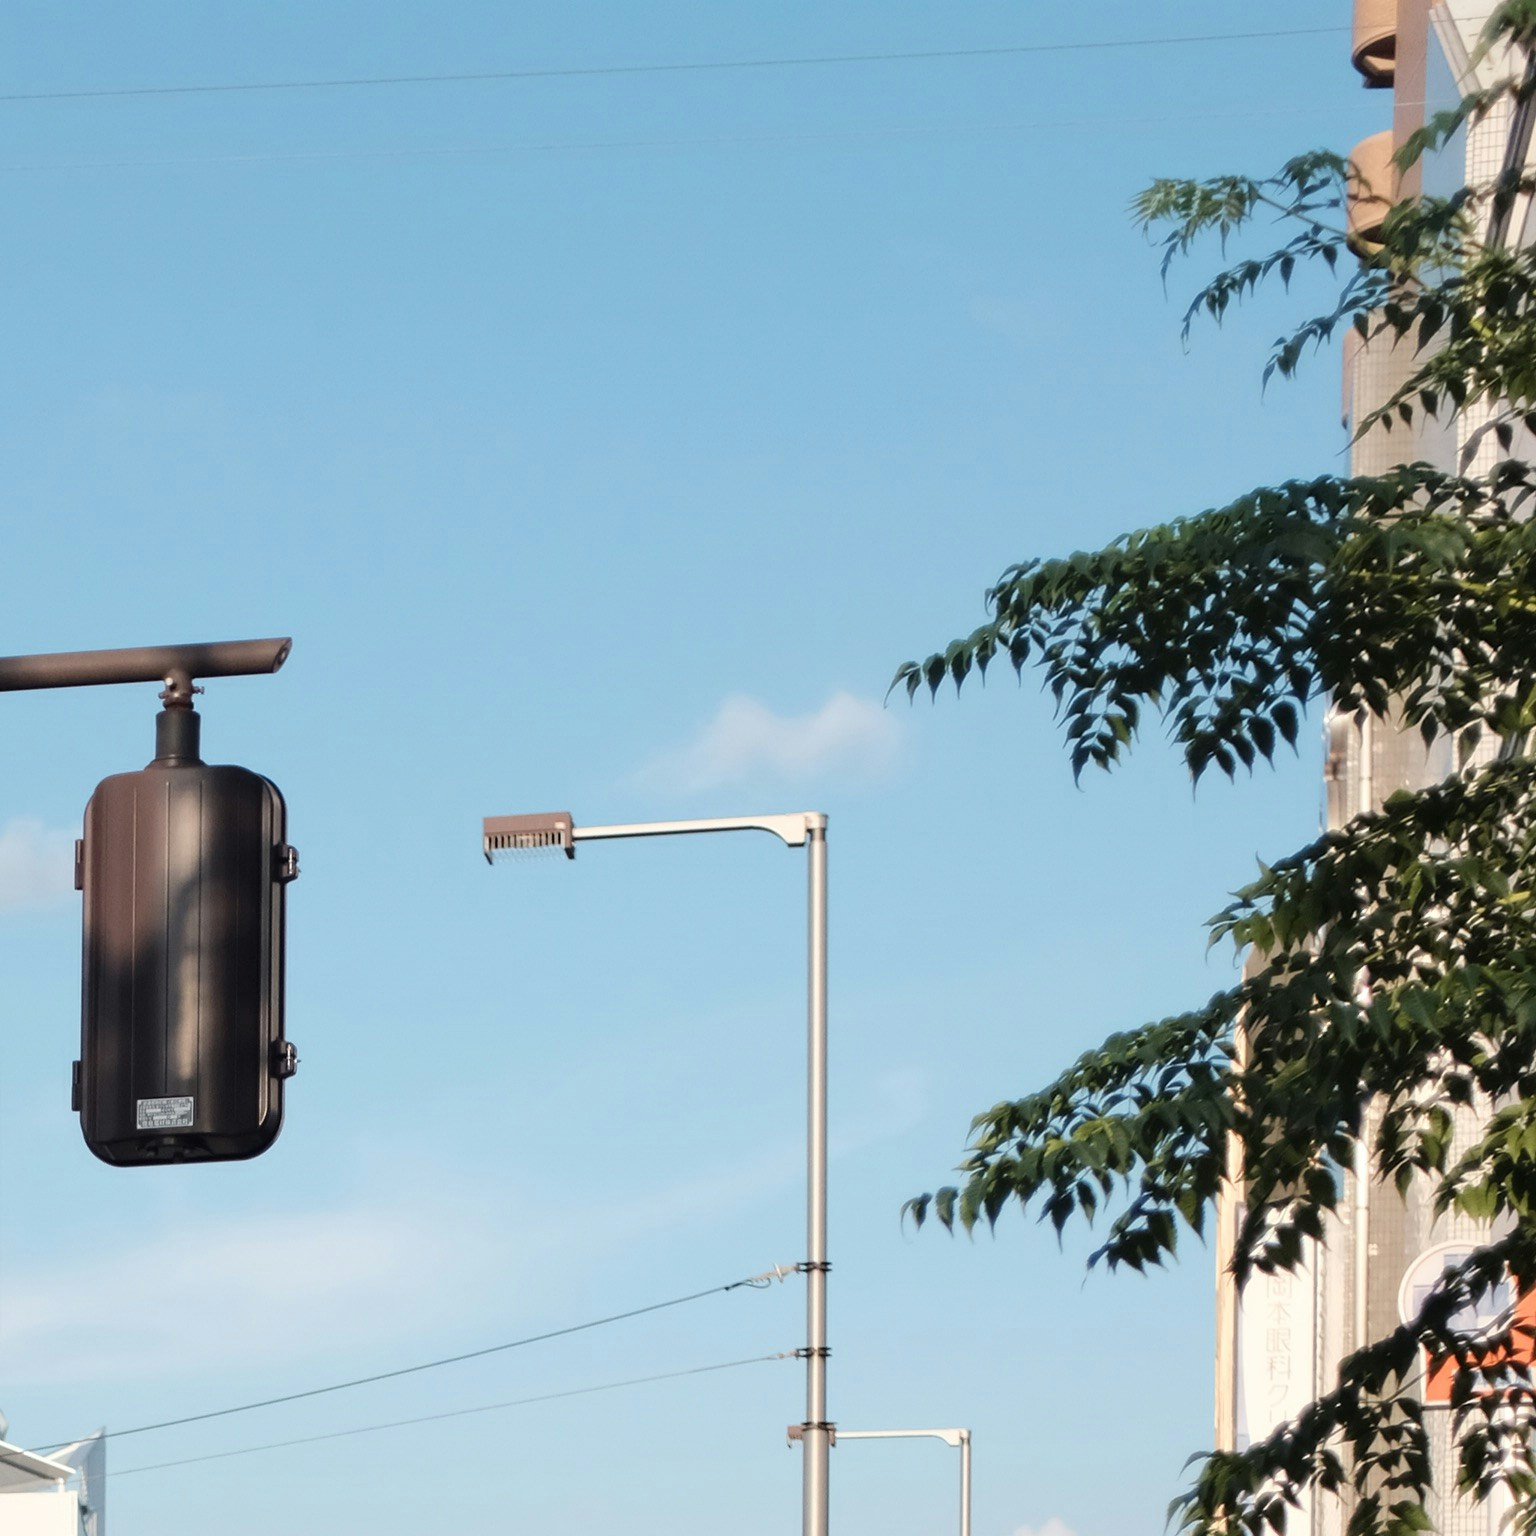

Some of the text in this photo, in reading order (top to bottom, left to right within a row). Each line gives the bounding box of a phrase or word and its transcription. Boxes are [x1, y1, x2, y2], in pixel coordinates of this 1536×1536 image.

[1266, 1273, 1293, 1424] 岡本眼科クリ
